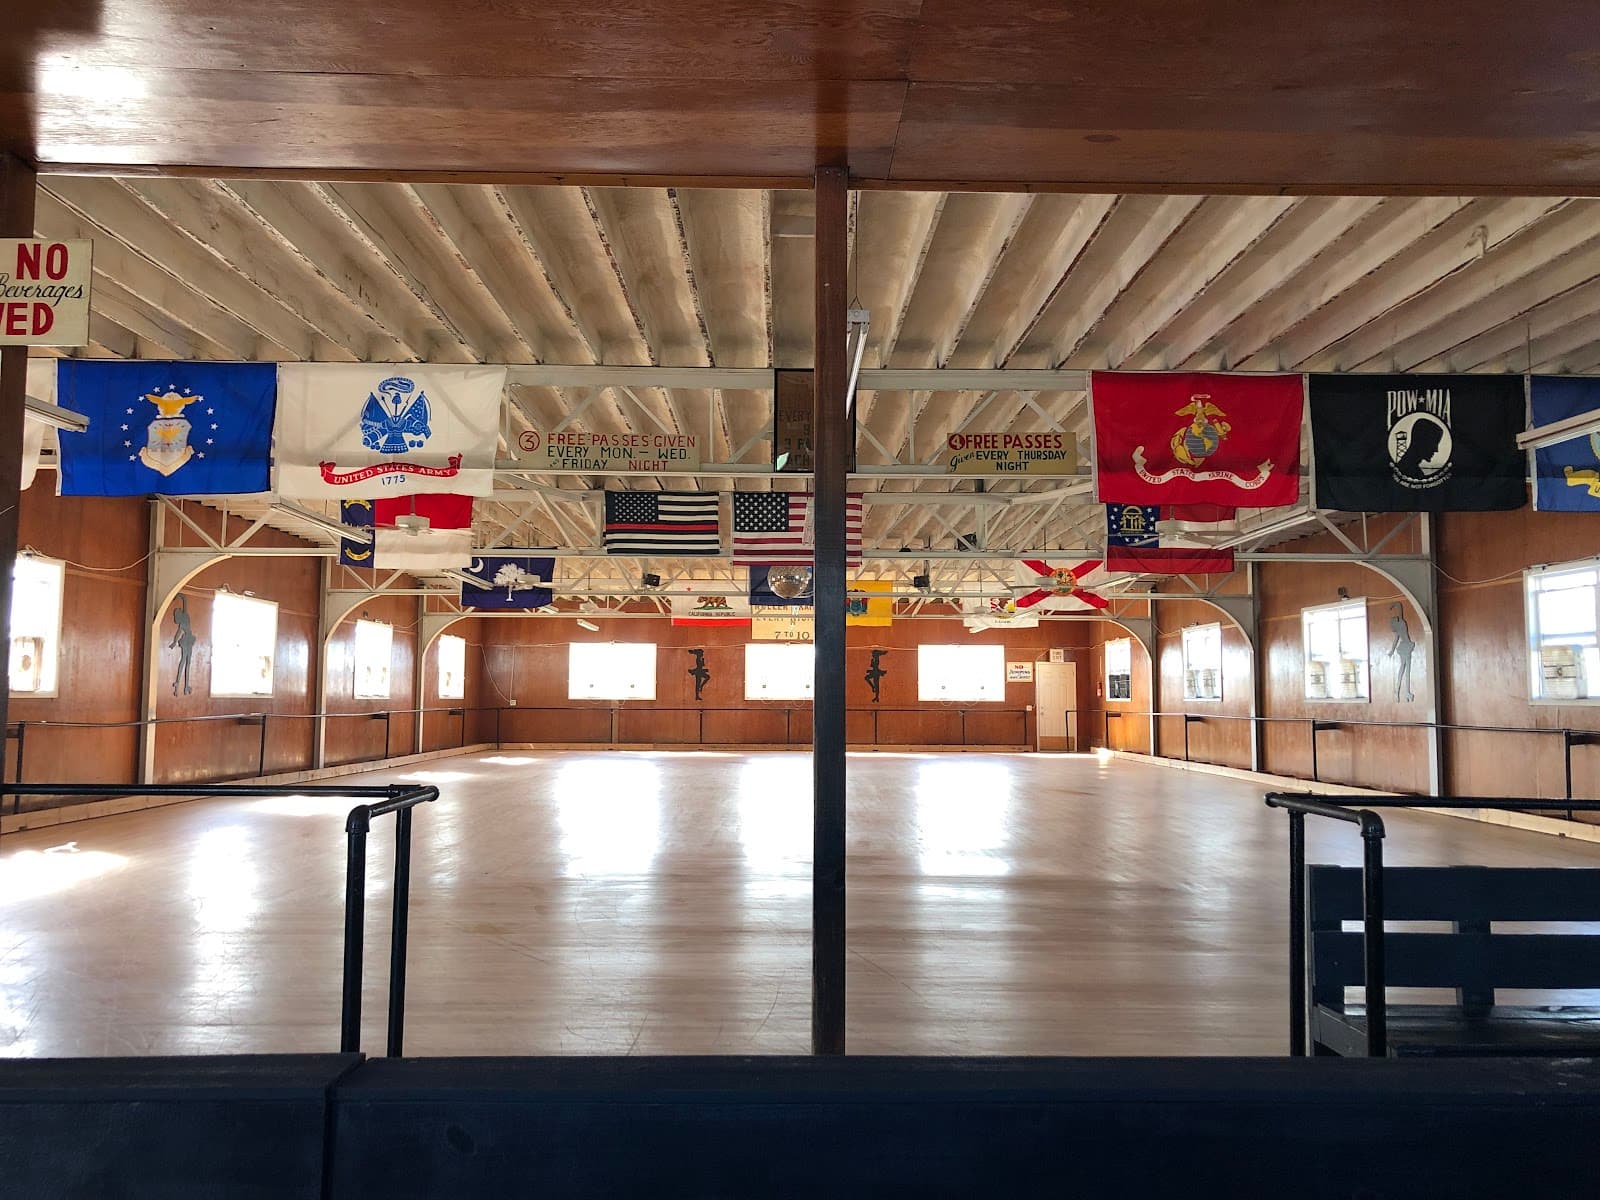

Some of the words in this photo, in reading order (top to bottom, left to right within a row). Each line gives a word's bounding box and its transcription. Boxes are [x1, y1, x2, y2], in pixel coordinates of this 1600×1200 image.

[16, 243, 68, 280] NO
[0, 272, 83, 307] Beverages
[0, 302, 54, 336] ED
[1386, 389, 1418, 431] POW
[1426, 388, 1451, 429] MIA
[518, 431, 540, 451] 3
[547, 433, 586, 446] FREE
[592, 434, 649, 447] PASSES
[653, 435, 696, 448] GIVEN
[950, 434, 965, 450] 4
[966, 435, 998, 449] FREE
[1003, 434, 1063, 449] PASSES
[547, 445, 589, 458] EVERY
[600, 446, 636, 459] MON.
[658, 448, 691, 460] WED.
[975, 450, 1009, 461] EVERY
[1017, 450, 1067, 461] THURSDAY
[562, 458, 608, 470] FRIDAY
[628, 460, 668, 471] NIGHT
[996, 461, 1029, 471] NIGHT
[333, 469, 374, 484] UNITED
[376, 463, 414, 474] STATES
[418, 467, 451, 476] ARMY
[381, 474, 406, 486] 1775
[1139, 469, 1162, 483] UNITED
[1171, 470, 1196, 480] STATES
[1208, 472, 1234, 481] MARINE
[775, 631, 781, 639] 7
[797, 631, 810, 640] 10
